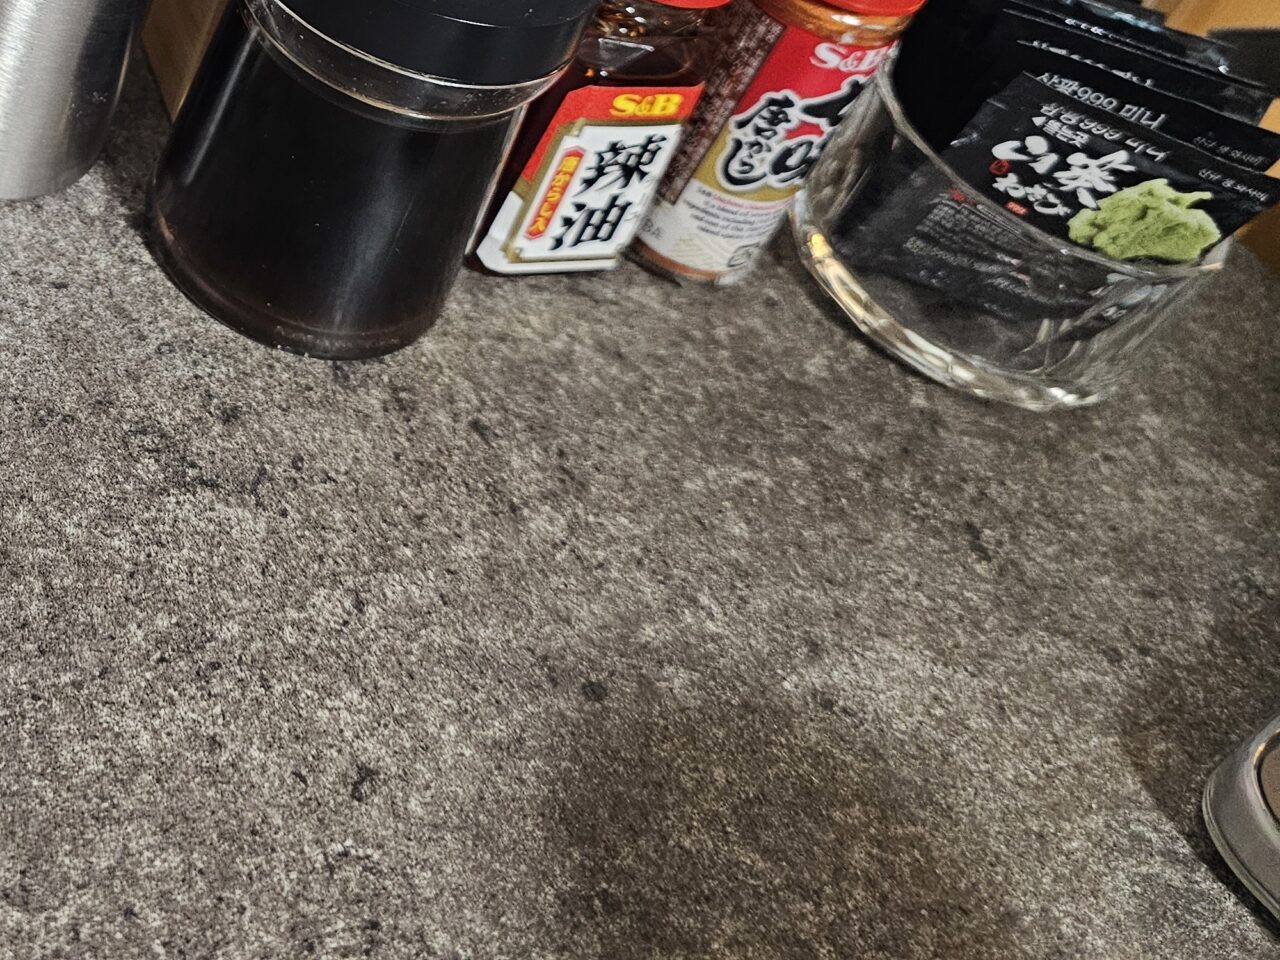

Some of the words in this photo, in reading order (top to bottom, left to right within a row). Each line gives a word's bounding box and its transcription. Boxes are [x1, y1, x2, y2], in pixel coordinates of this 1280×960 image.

[609, 93, 684, 117] S&B
[1119, 103, 1169, 130] 미니
[549, 134, 668, 250] 辣油
